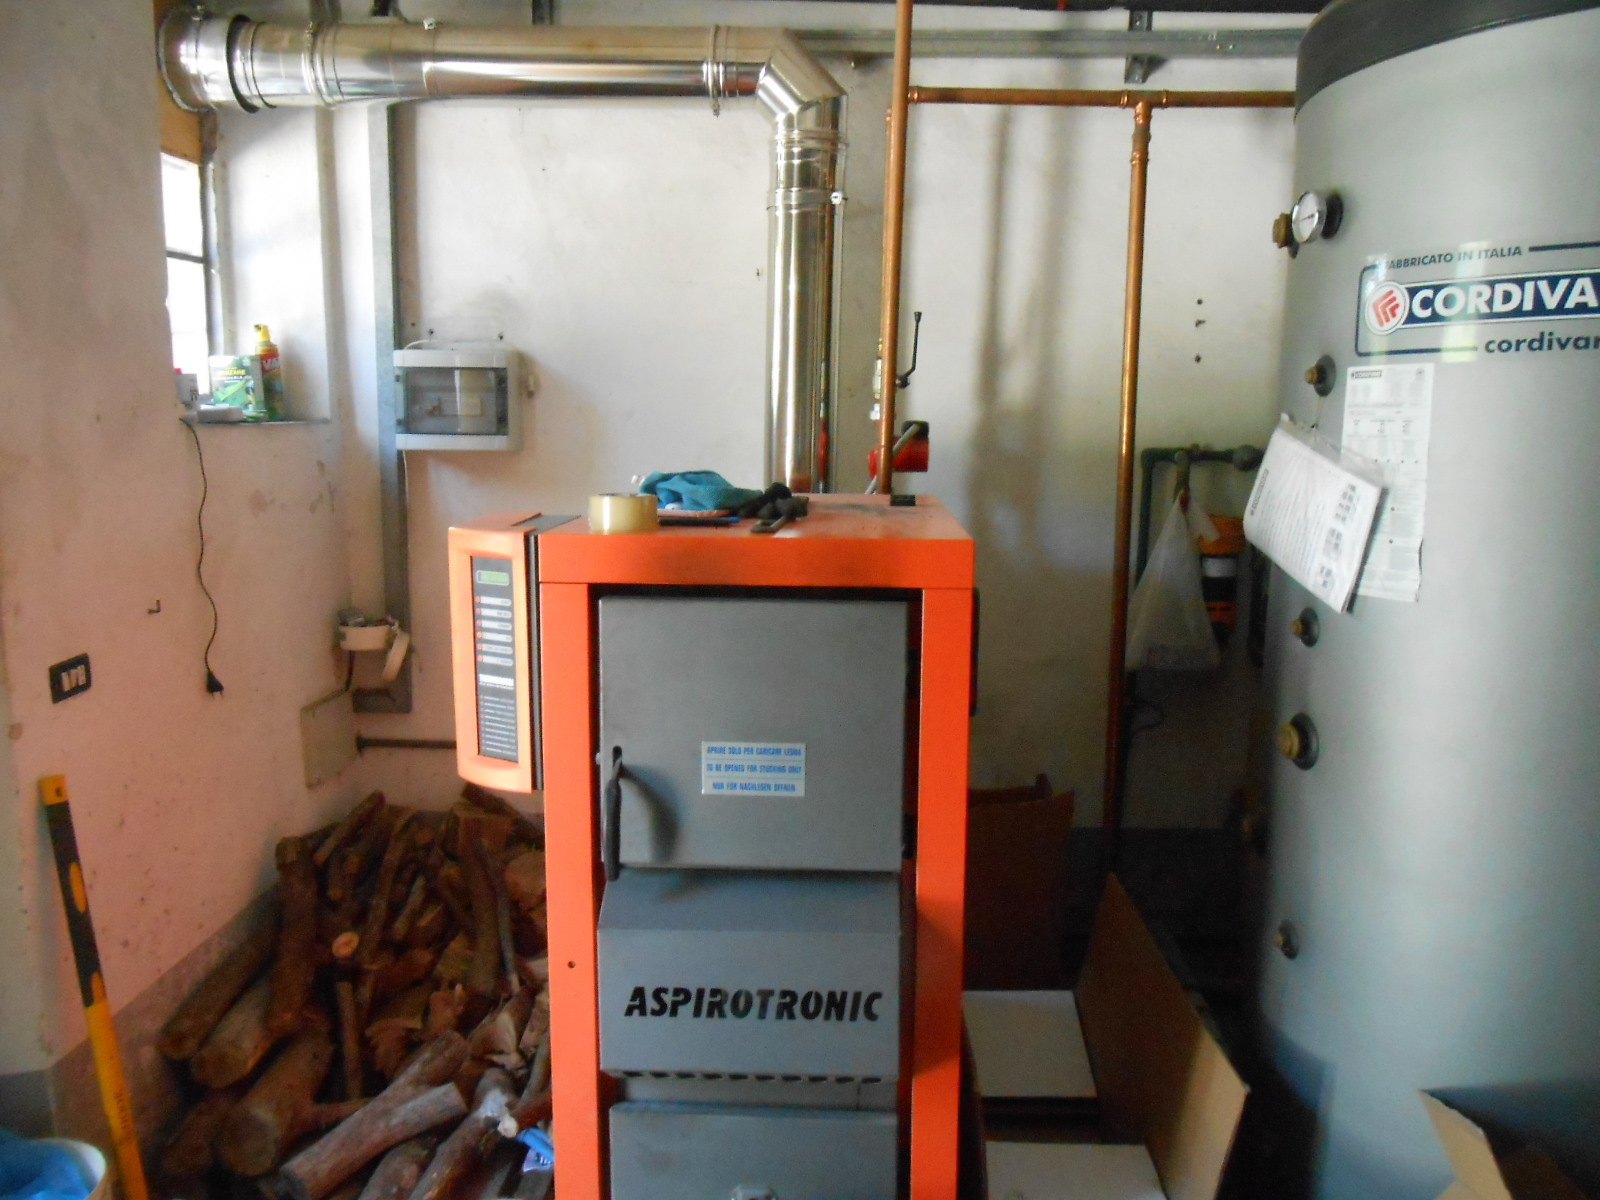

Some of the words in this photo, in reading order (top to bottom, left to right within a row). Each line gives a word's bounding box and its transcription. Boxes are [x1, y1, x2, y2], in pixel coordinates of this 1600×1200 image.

[1457, 250, 1474, 262] IN
[1478, 246, 1522, 260] ITALIA
[1411, 276, 1599, 318] CORDIVA
[743, 747, 754, 755] PER
[706, 763, 714, 772] TO
[715, 764, 722, 772] BE
[724, 764, 745, 772] OPENED
[747, 765, 758, 773] FOR
[624, 986, 884, 1022] ASPIROTRONIC
